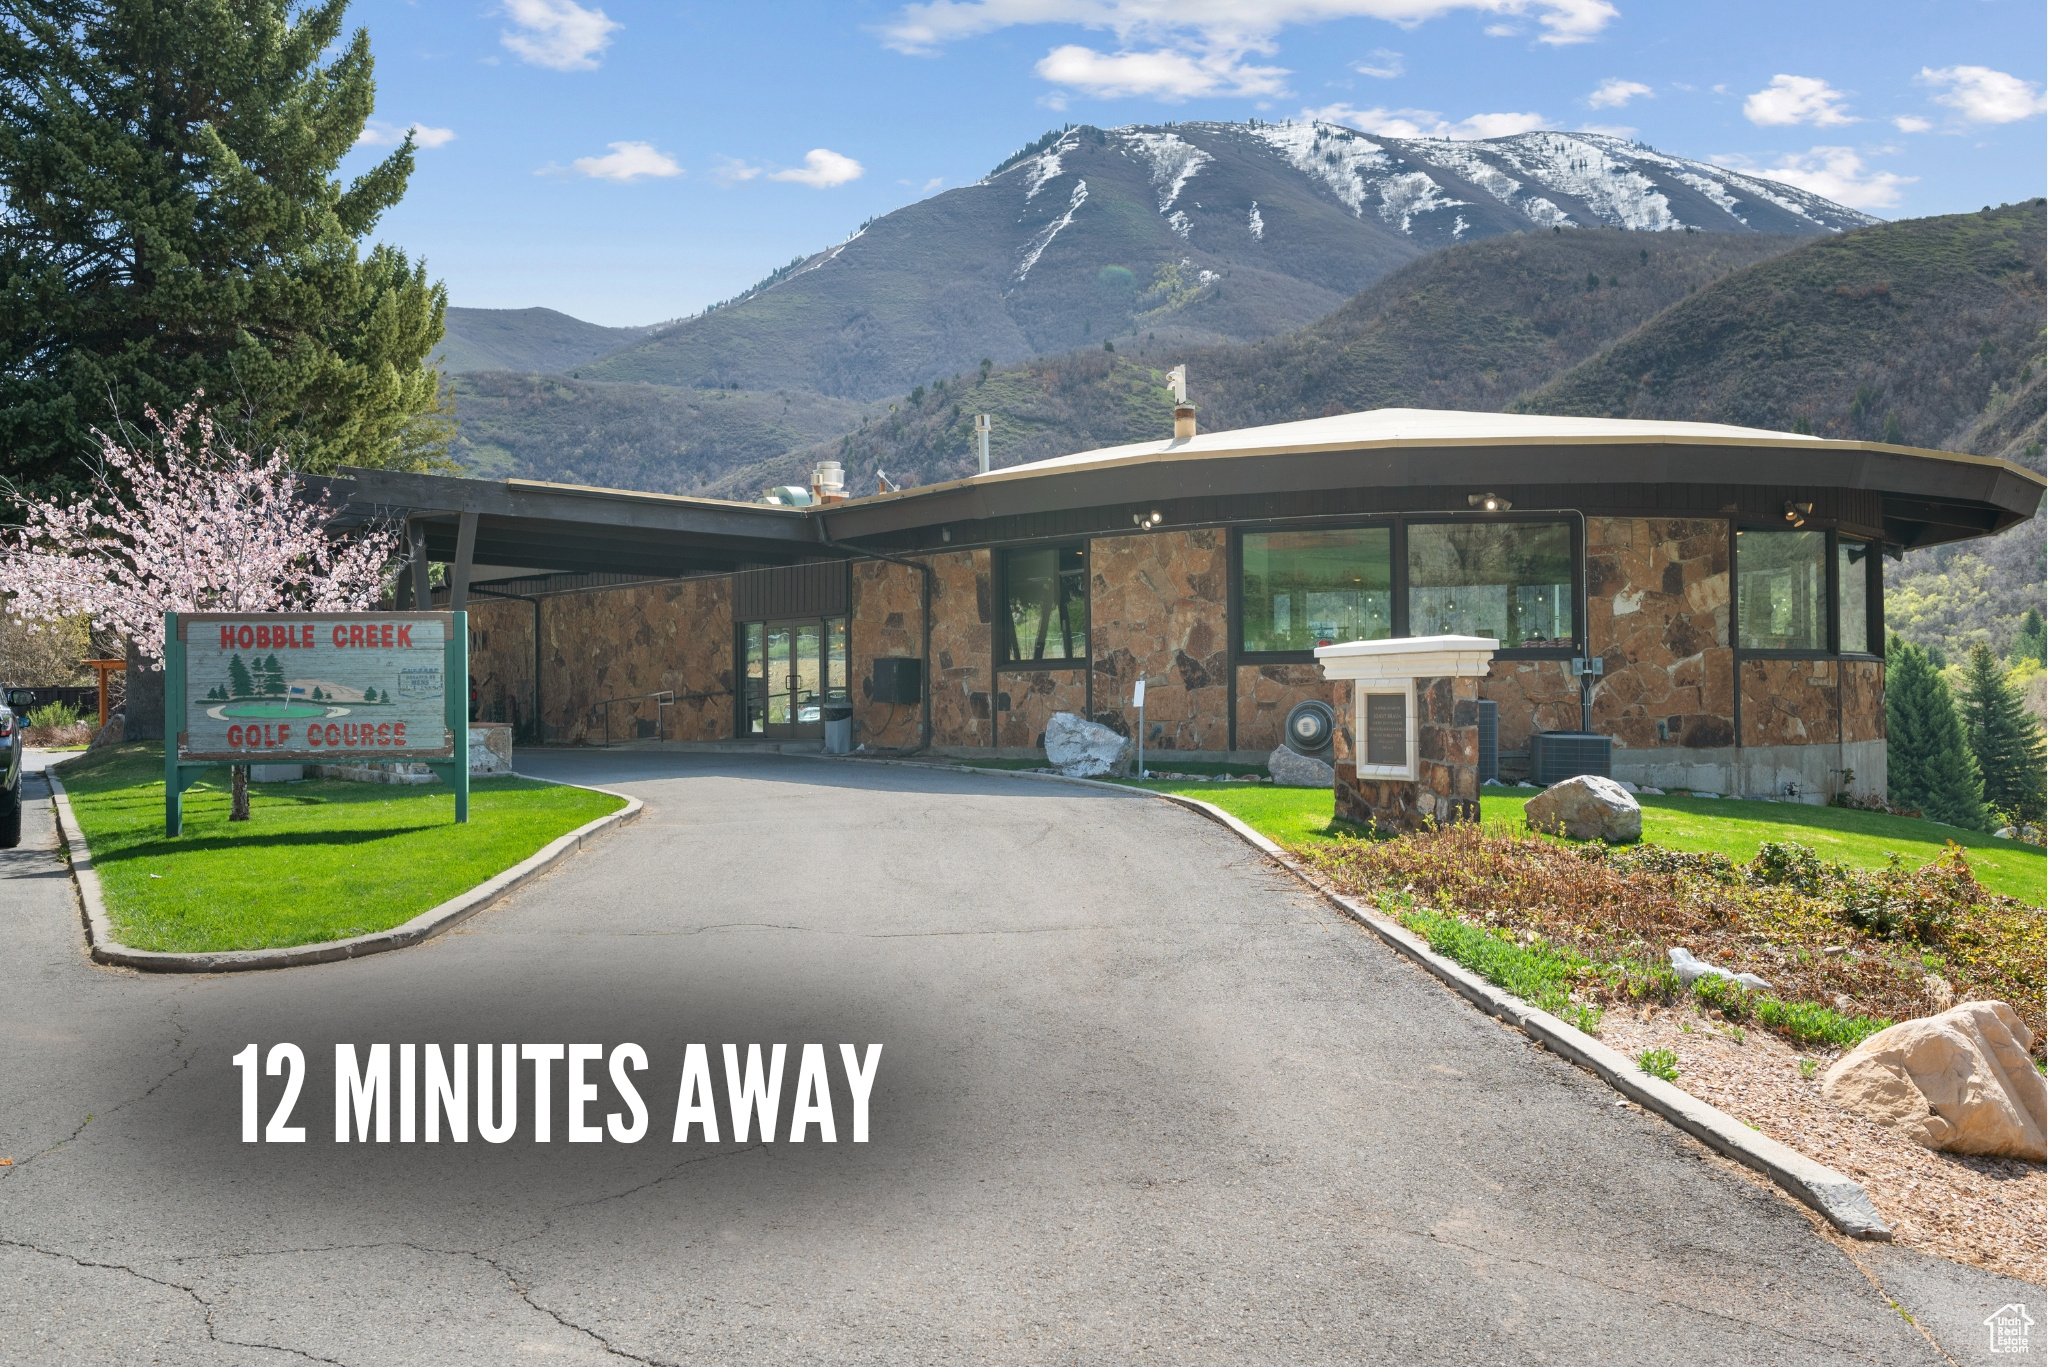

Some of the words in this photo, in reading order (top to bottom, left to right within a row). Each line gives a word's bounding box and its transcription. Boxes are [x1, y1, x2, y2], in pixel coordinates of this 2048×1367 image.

[220, 625, 315, 649] HOBBLE
[332, 624, 413, 648] CREEK
[227, 724, 291, 747] GOLF
[307, 723, 407, 746] COURSE
